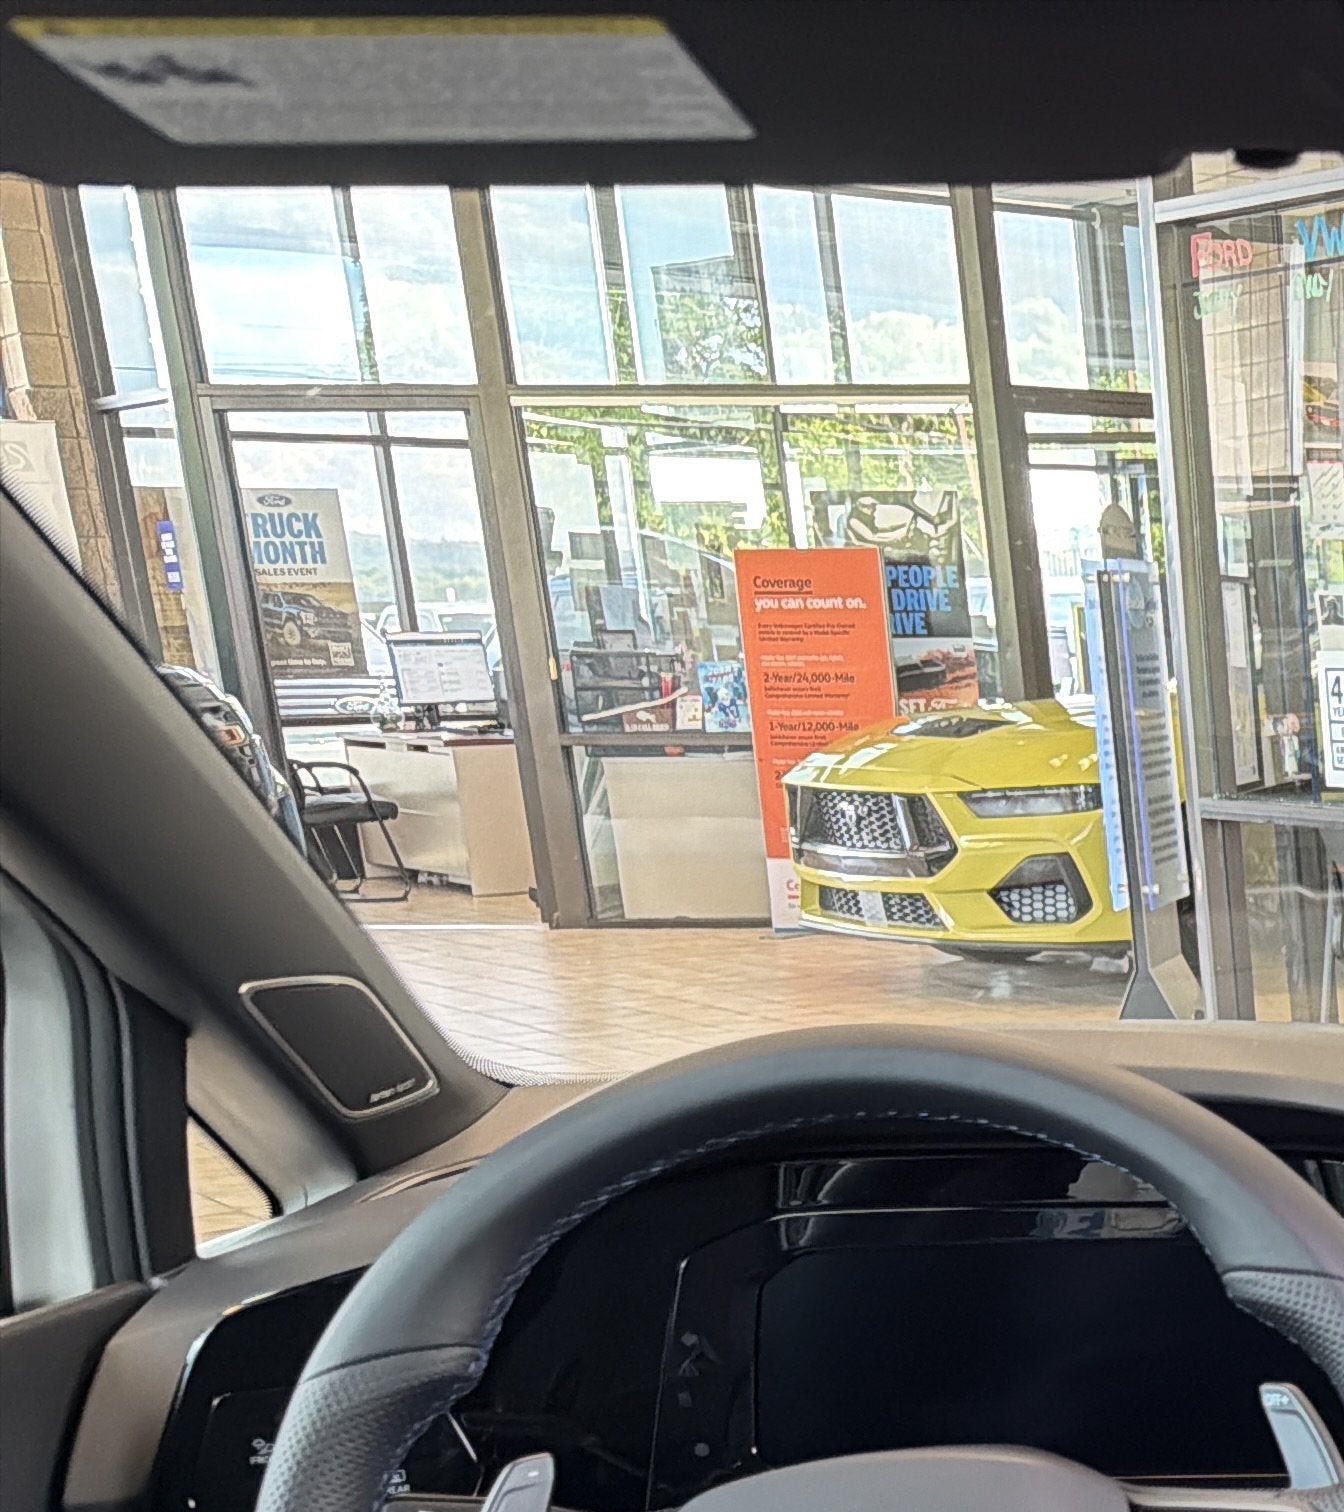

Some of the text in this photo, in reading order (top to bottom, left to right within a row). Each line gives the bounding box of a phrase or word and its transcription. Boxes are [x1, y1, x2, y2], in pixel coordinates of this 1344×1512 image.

[1190, 231, 1252, 278] FORD
[247, 512, 323, 539] RUCK
[255, 567, 318, 577] SALES EVENT
[886, 565, 959, 588] PEOPLE
[753, 575, 812, 591] Coverage
[754, 597, 867, 613] you can count on.
[892, 588, 952, 612] DRIVE
[763, 672, 855, 684] 2-Year/24,000-Mile
[769, 721, 859, 732] 1-Year/12,000-Mile
